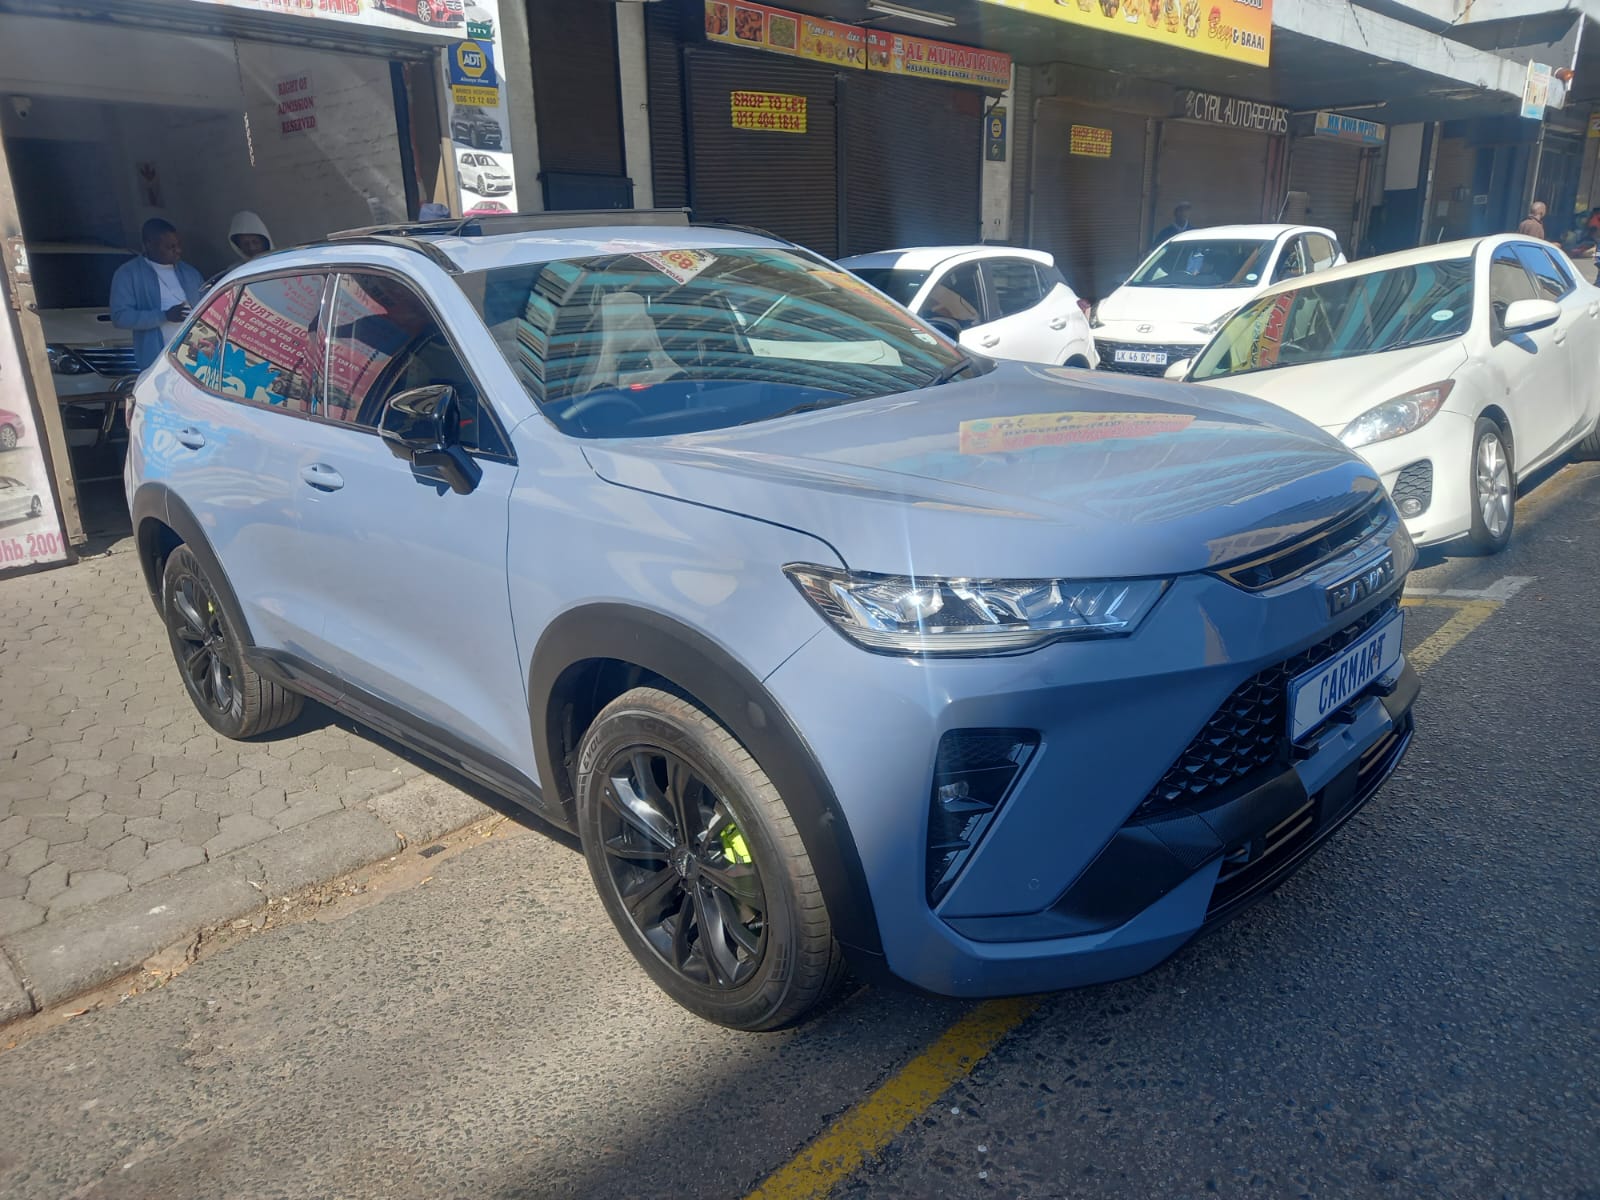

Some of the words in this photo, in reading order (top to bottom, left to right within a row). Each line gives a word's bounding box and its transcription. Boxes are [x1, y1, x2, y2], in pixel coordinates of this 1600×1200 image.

[1241, 31, 1265, 51] BRAAI
[463, 51, 482, 67] ADT
[906, 42, 922, 61] AL
[278, 96, 315, 115] ADMISSION
[734, 92, 764, 108] SHOP
[768, 95, 782, 110] TO
[785, 97, 805, 113] LET
[1194, 92, 1223, 123] CYRIL
[282, 115, 316, 133] RESERVED
[1155, 354, 1166, 363] GP
[1318, 632, 1387, 715] CARMART
